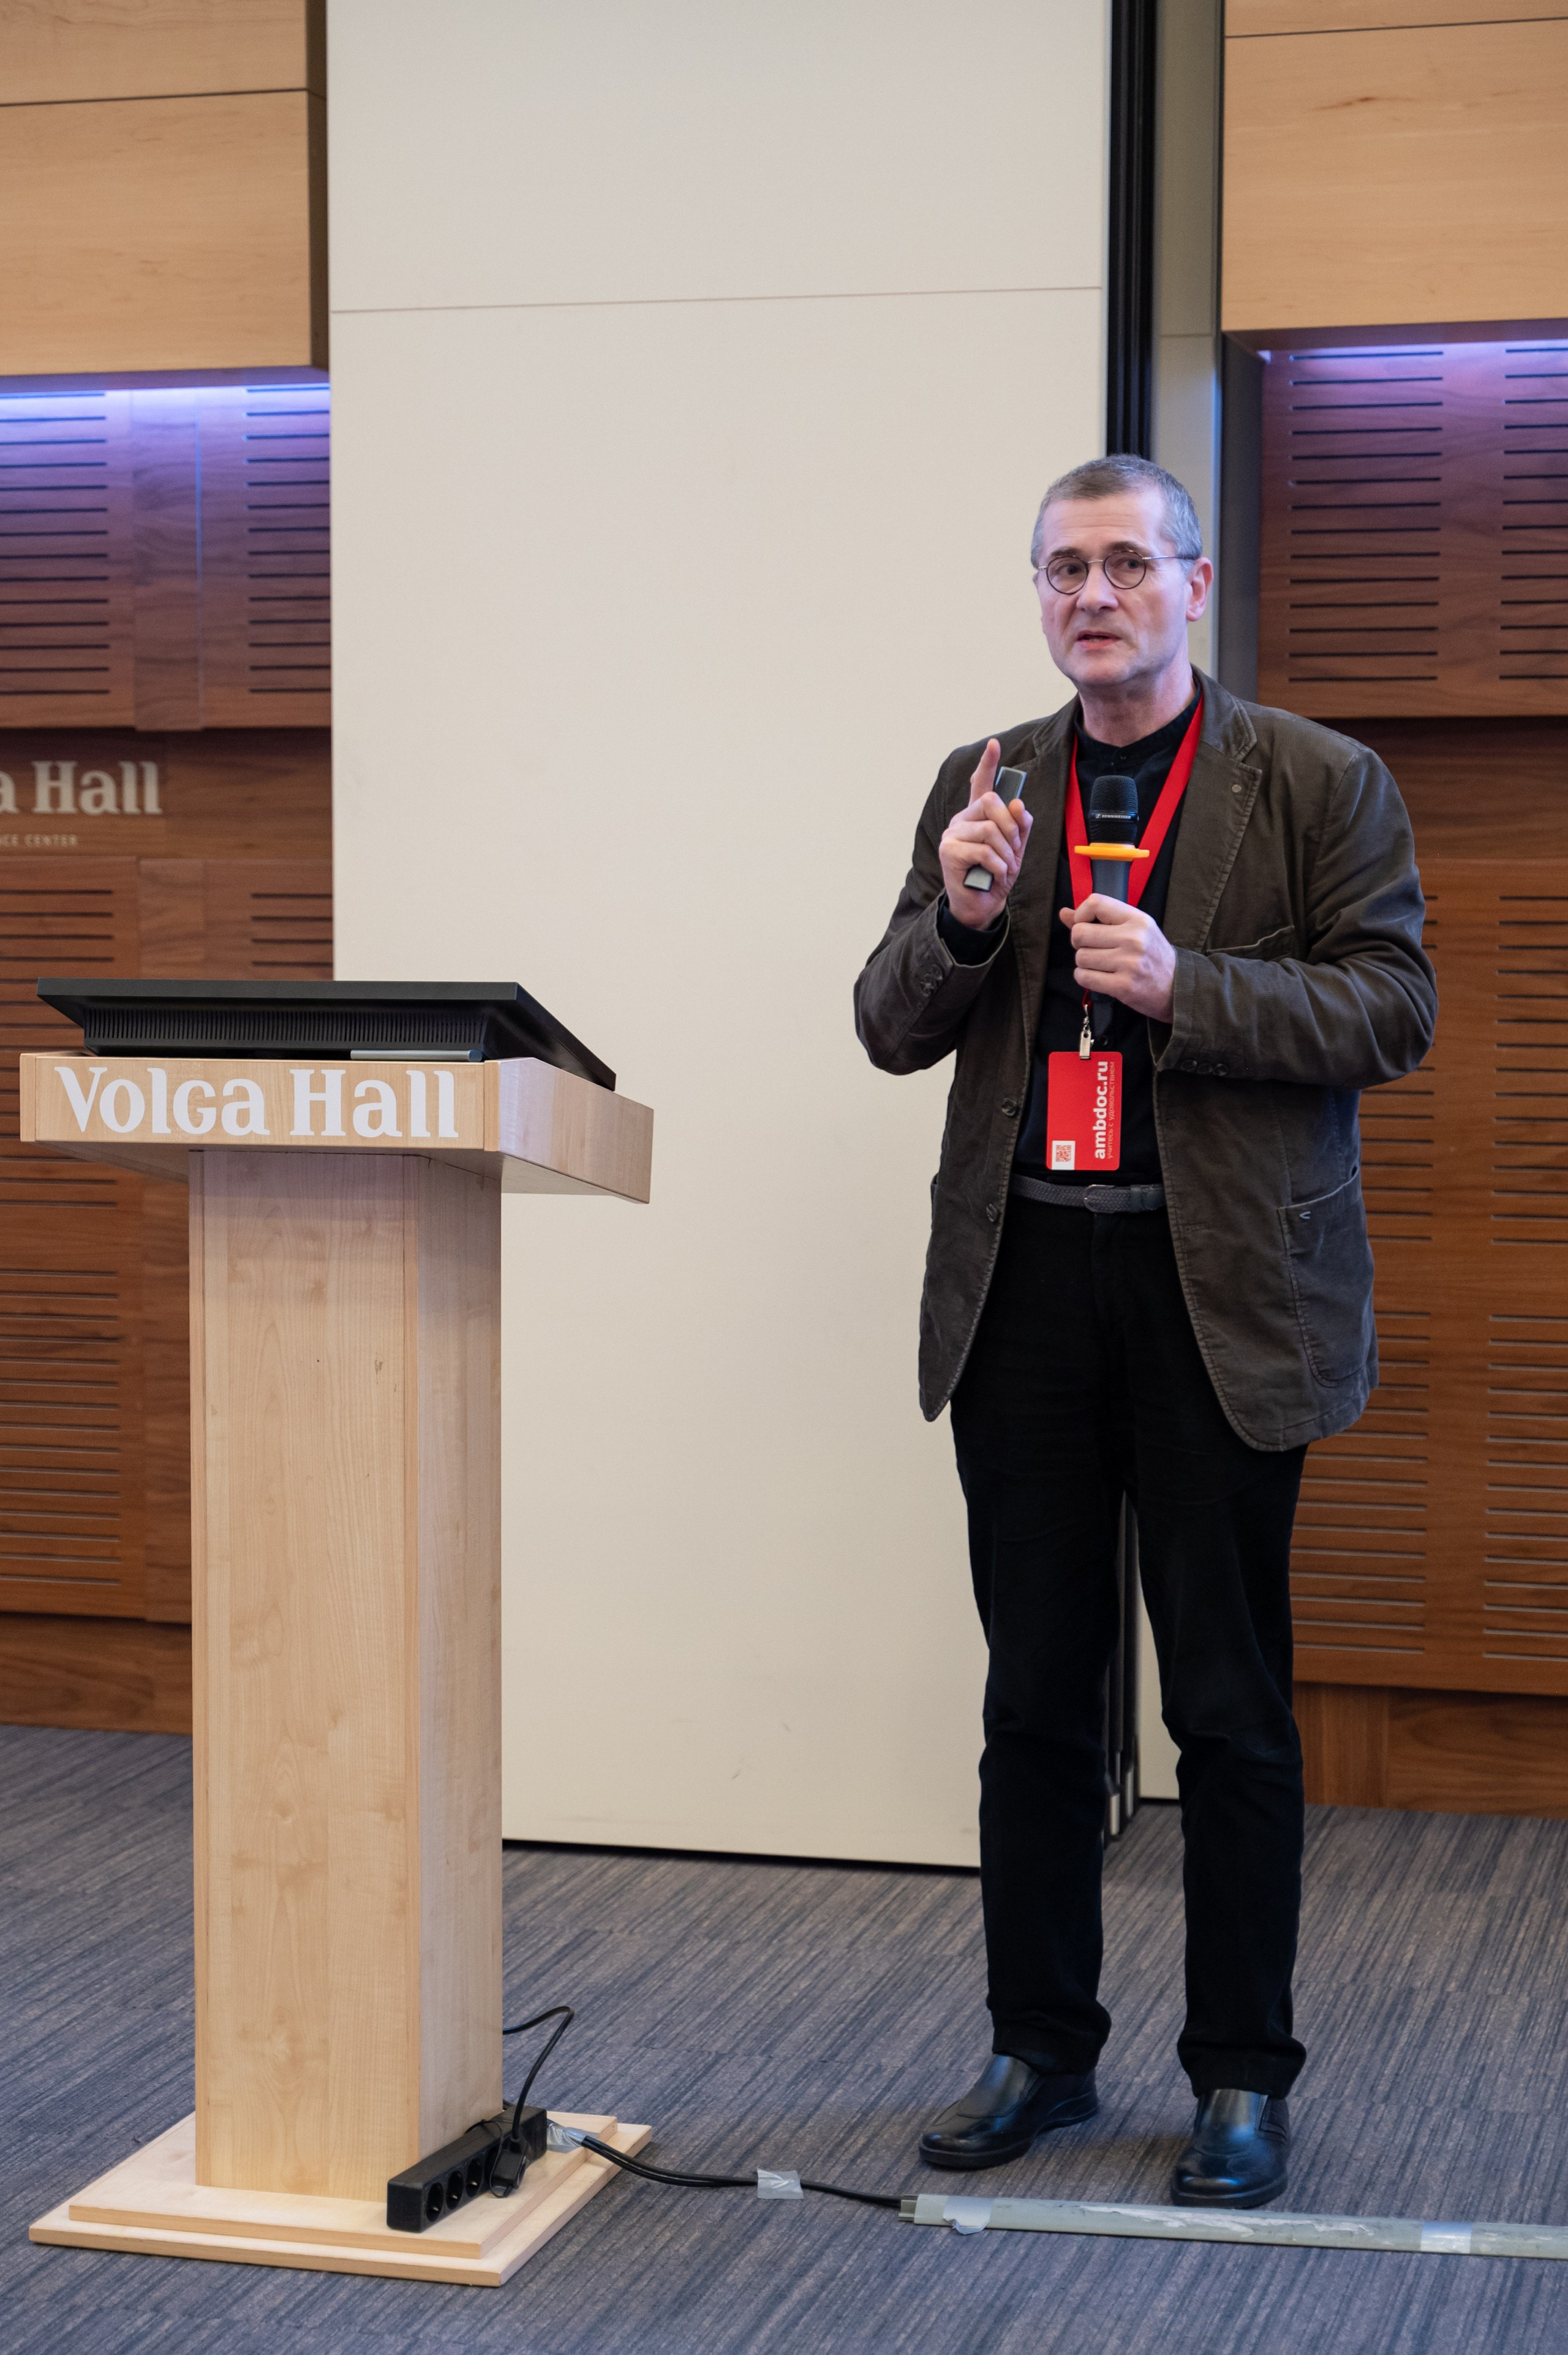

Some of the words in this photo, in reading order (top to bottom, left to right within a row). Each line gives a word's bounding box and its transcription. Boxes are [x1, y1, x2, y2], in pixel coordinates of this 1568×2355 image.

[32, 760, 162, 815] Hall
[290, 1069, 459, 1138] Hall
[1093, 1061, 1108, 1159] ambdoc.ru
